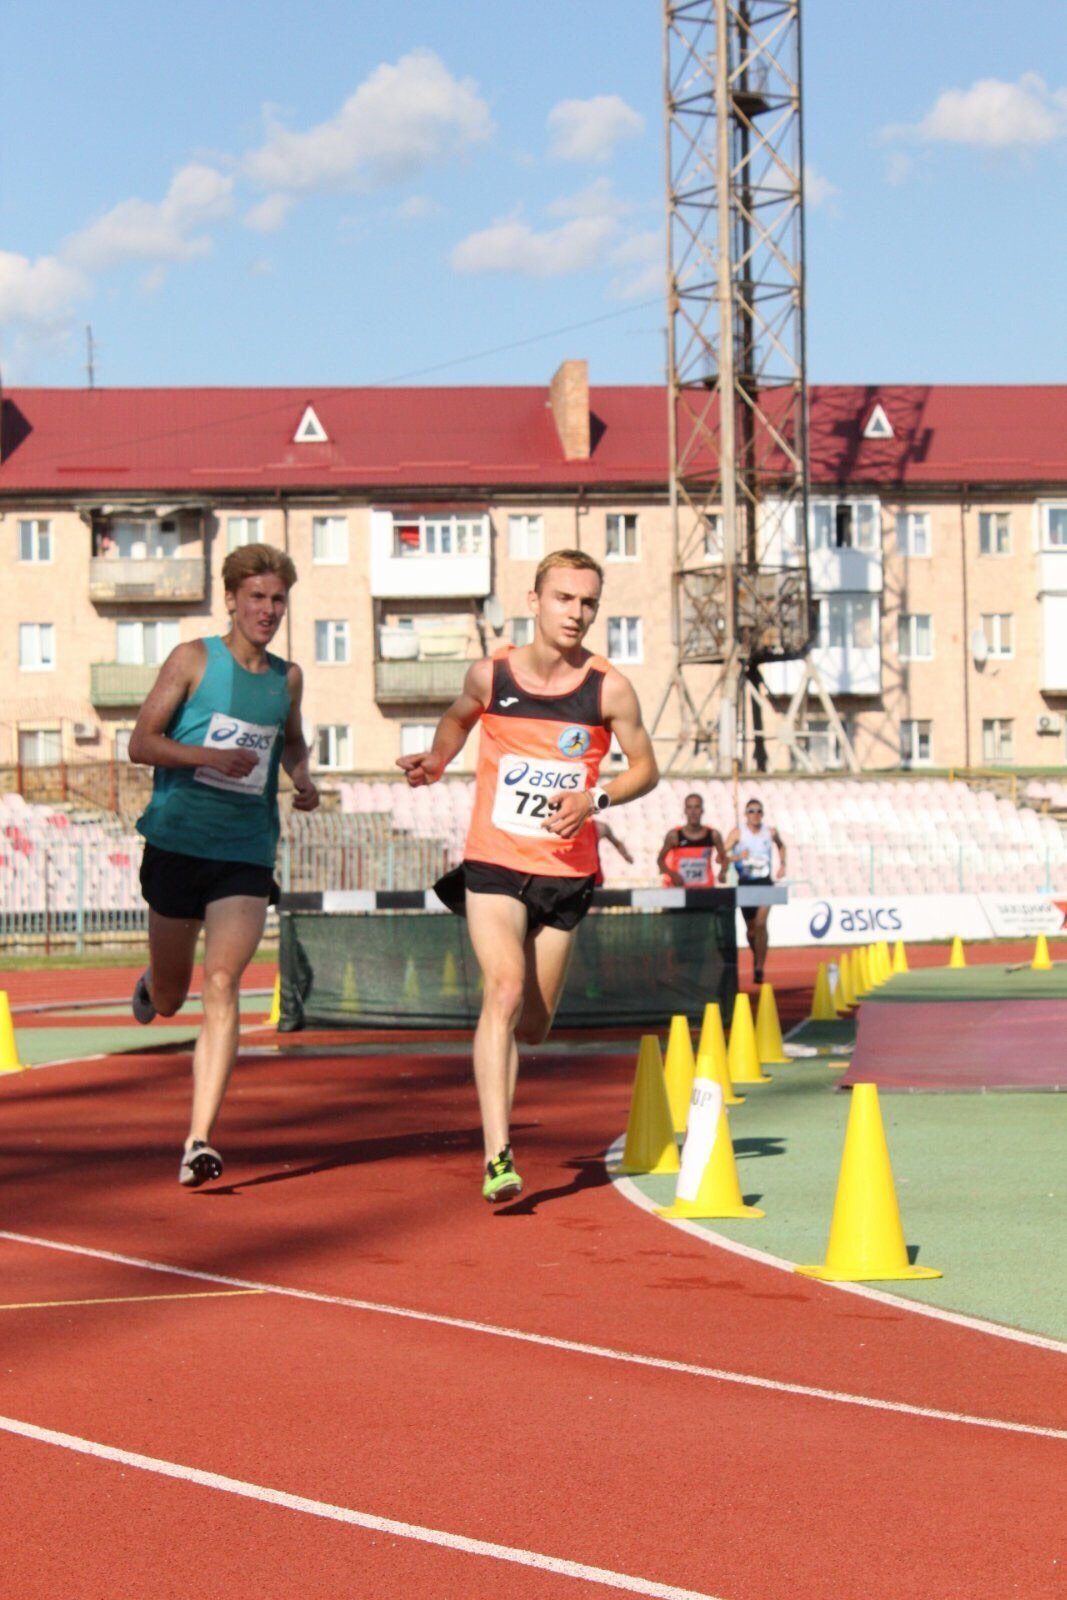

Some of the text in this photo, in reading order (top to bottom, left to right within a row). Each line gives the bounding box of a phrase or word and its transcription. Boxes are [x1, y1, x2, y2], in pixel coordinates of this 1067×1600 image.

[235, 732, 272, 750] asics
[529, 770, 580, 789] asics
[840, 908, 902, 931] asics
